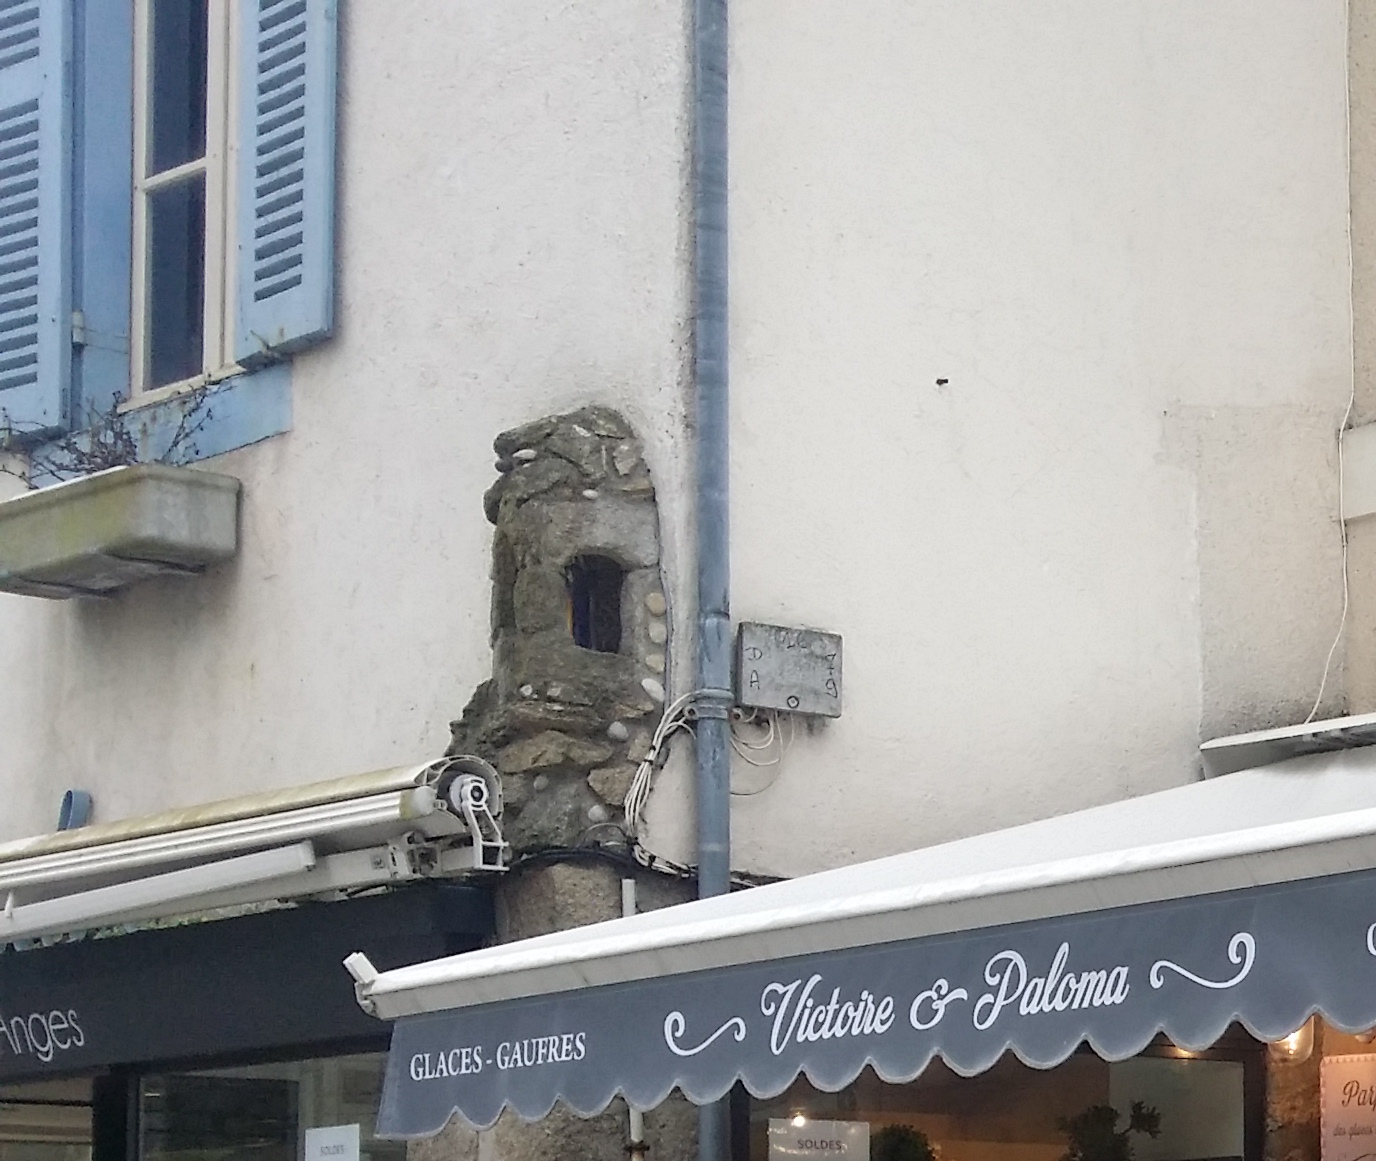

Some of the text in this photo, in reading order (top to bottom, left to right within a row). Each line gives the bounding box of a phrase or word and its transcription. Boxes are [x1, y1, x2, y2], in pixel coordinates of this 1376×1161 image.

[761, 942, 1130, 1056] Victoire & Paloma
[409, 1045, 483, 1081] GLACES
[496, 1031, 586, 1071] GAUFRES
[797, 1139, 843, 1151] SOLDES
